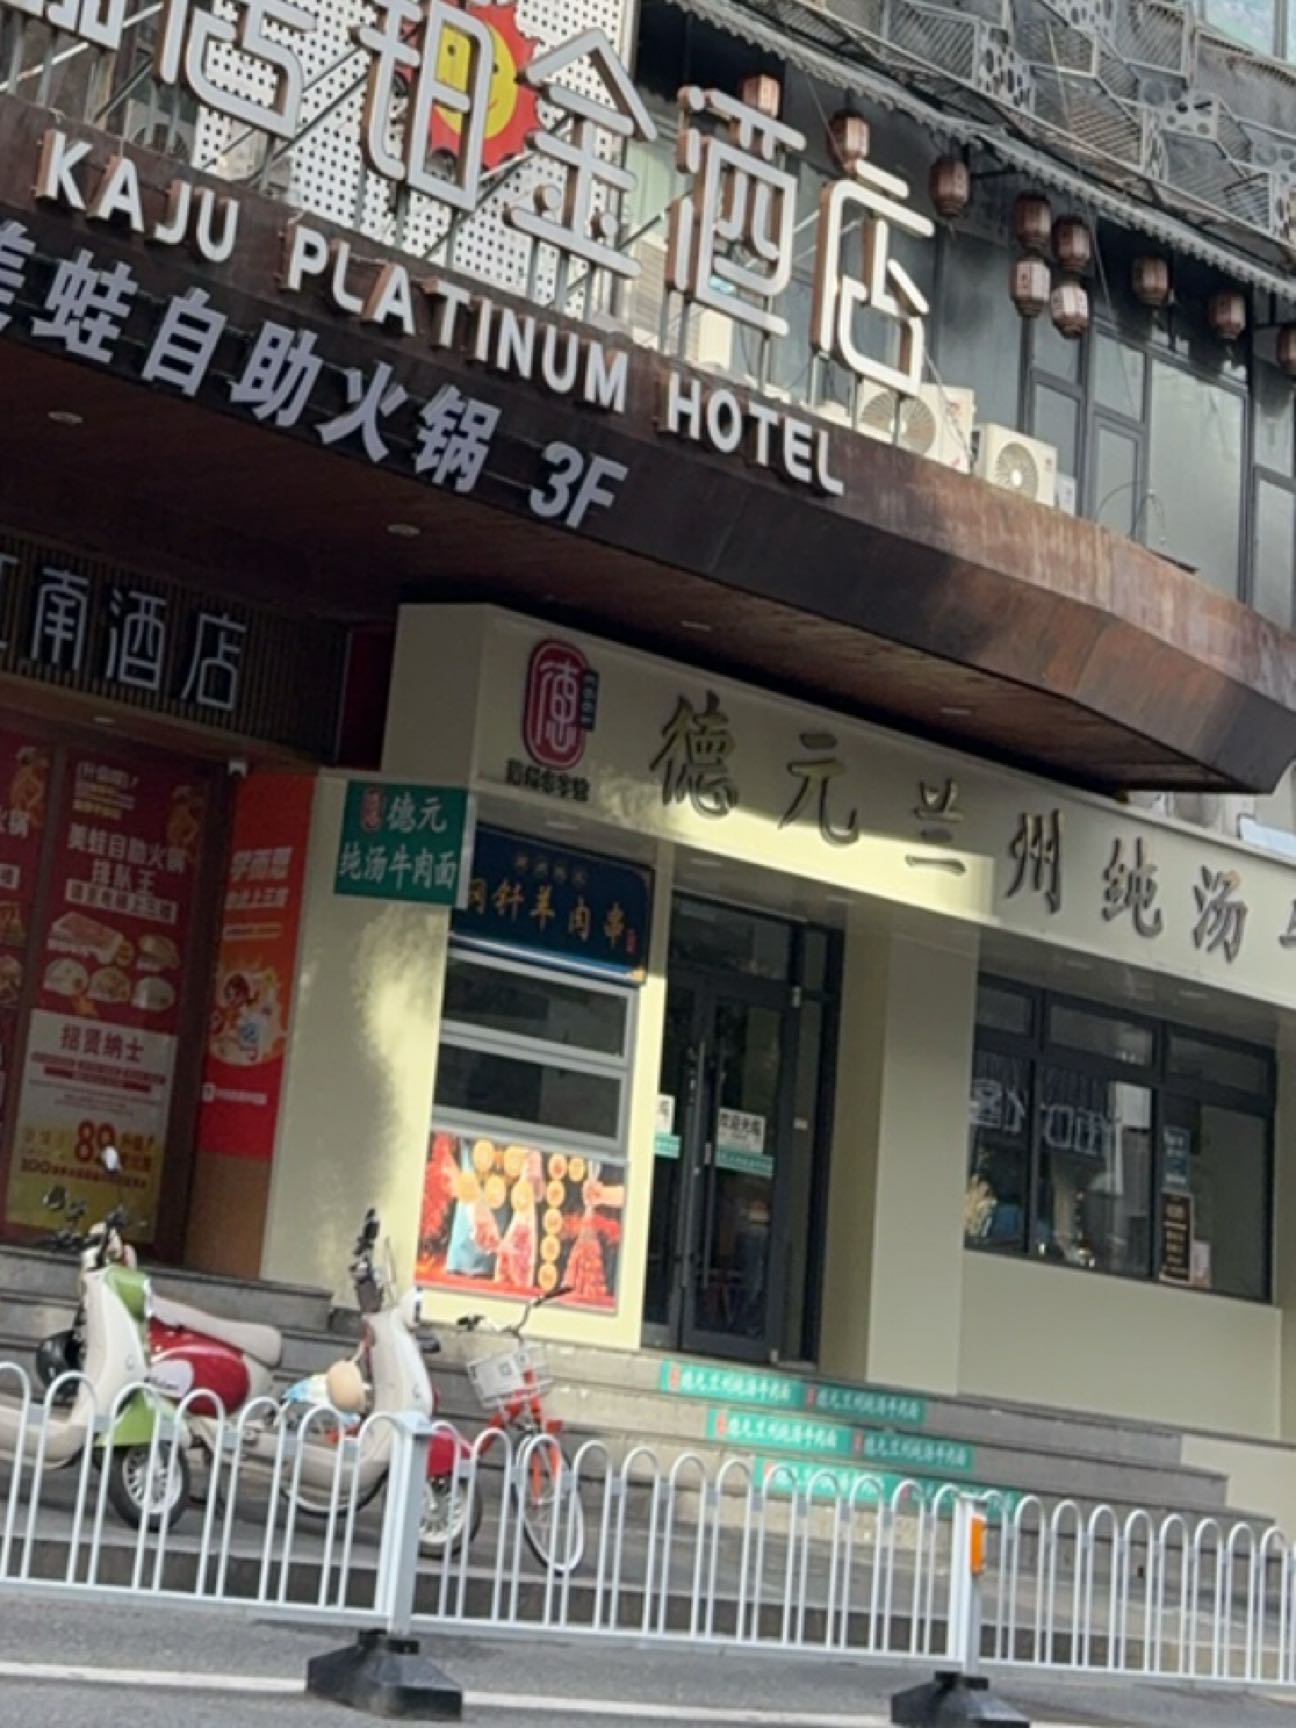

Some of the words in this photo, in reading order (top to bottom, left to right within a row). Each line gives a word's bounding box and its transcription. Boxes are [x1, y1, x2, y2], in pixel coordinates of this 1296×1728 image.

[38, 130, 239, 263] KAJU
[288, 227, 628, 413] PLATINUM
[664, 379, 846, 496] HOTEL
[529, 439, 629, 530] 3F
[385, 790, 448, 833] 德元
[339, 841, 458, 891] 纯汤牛肉面
